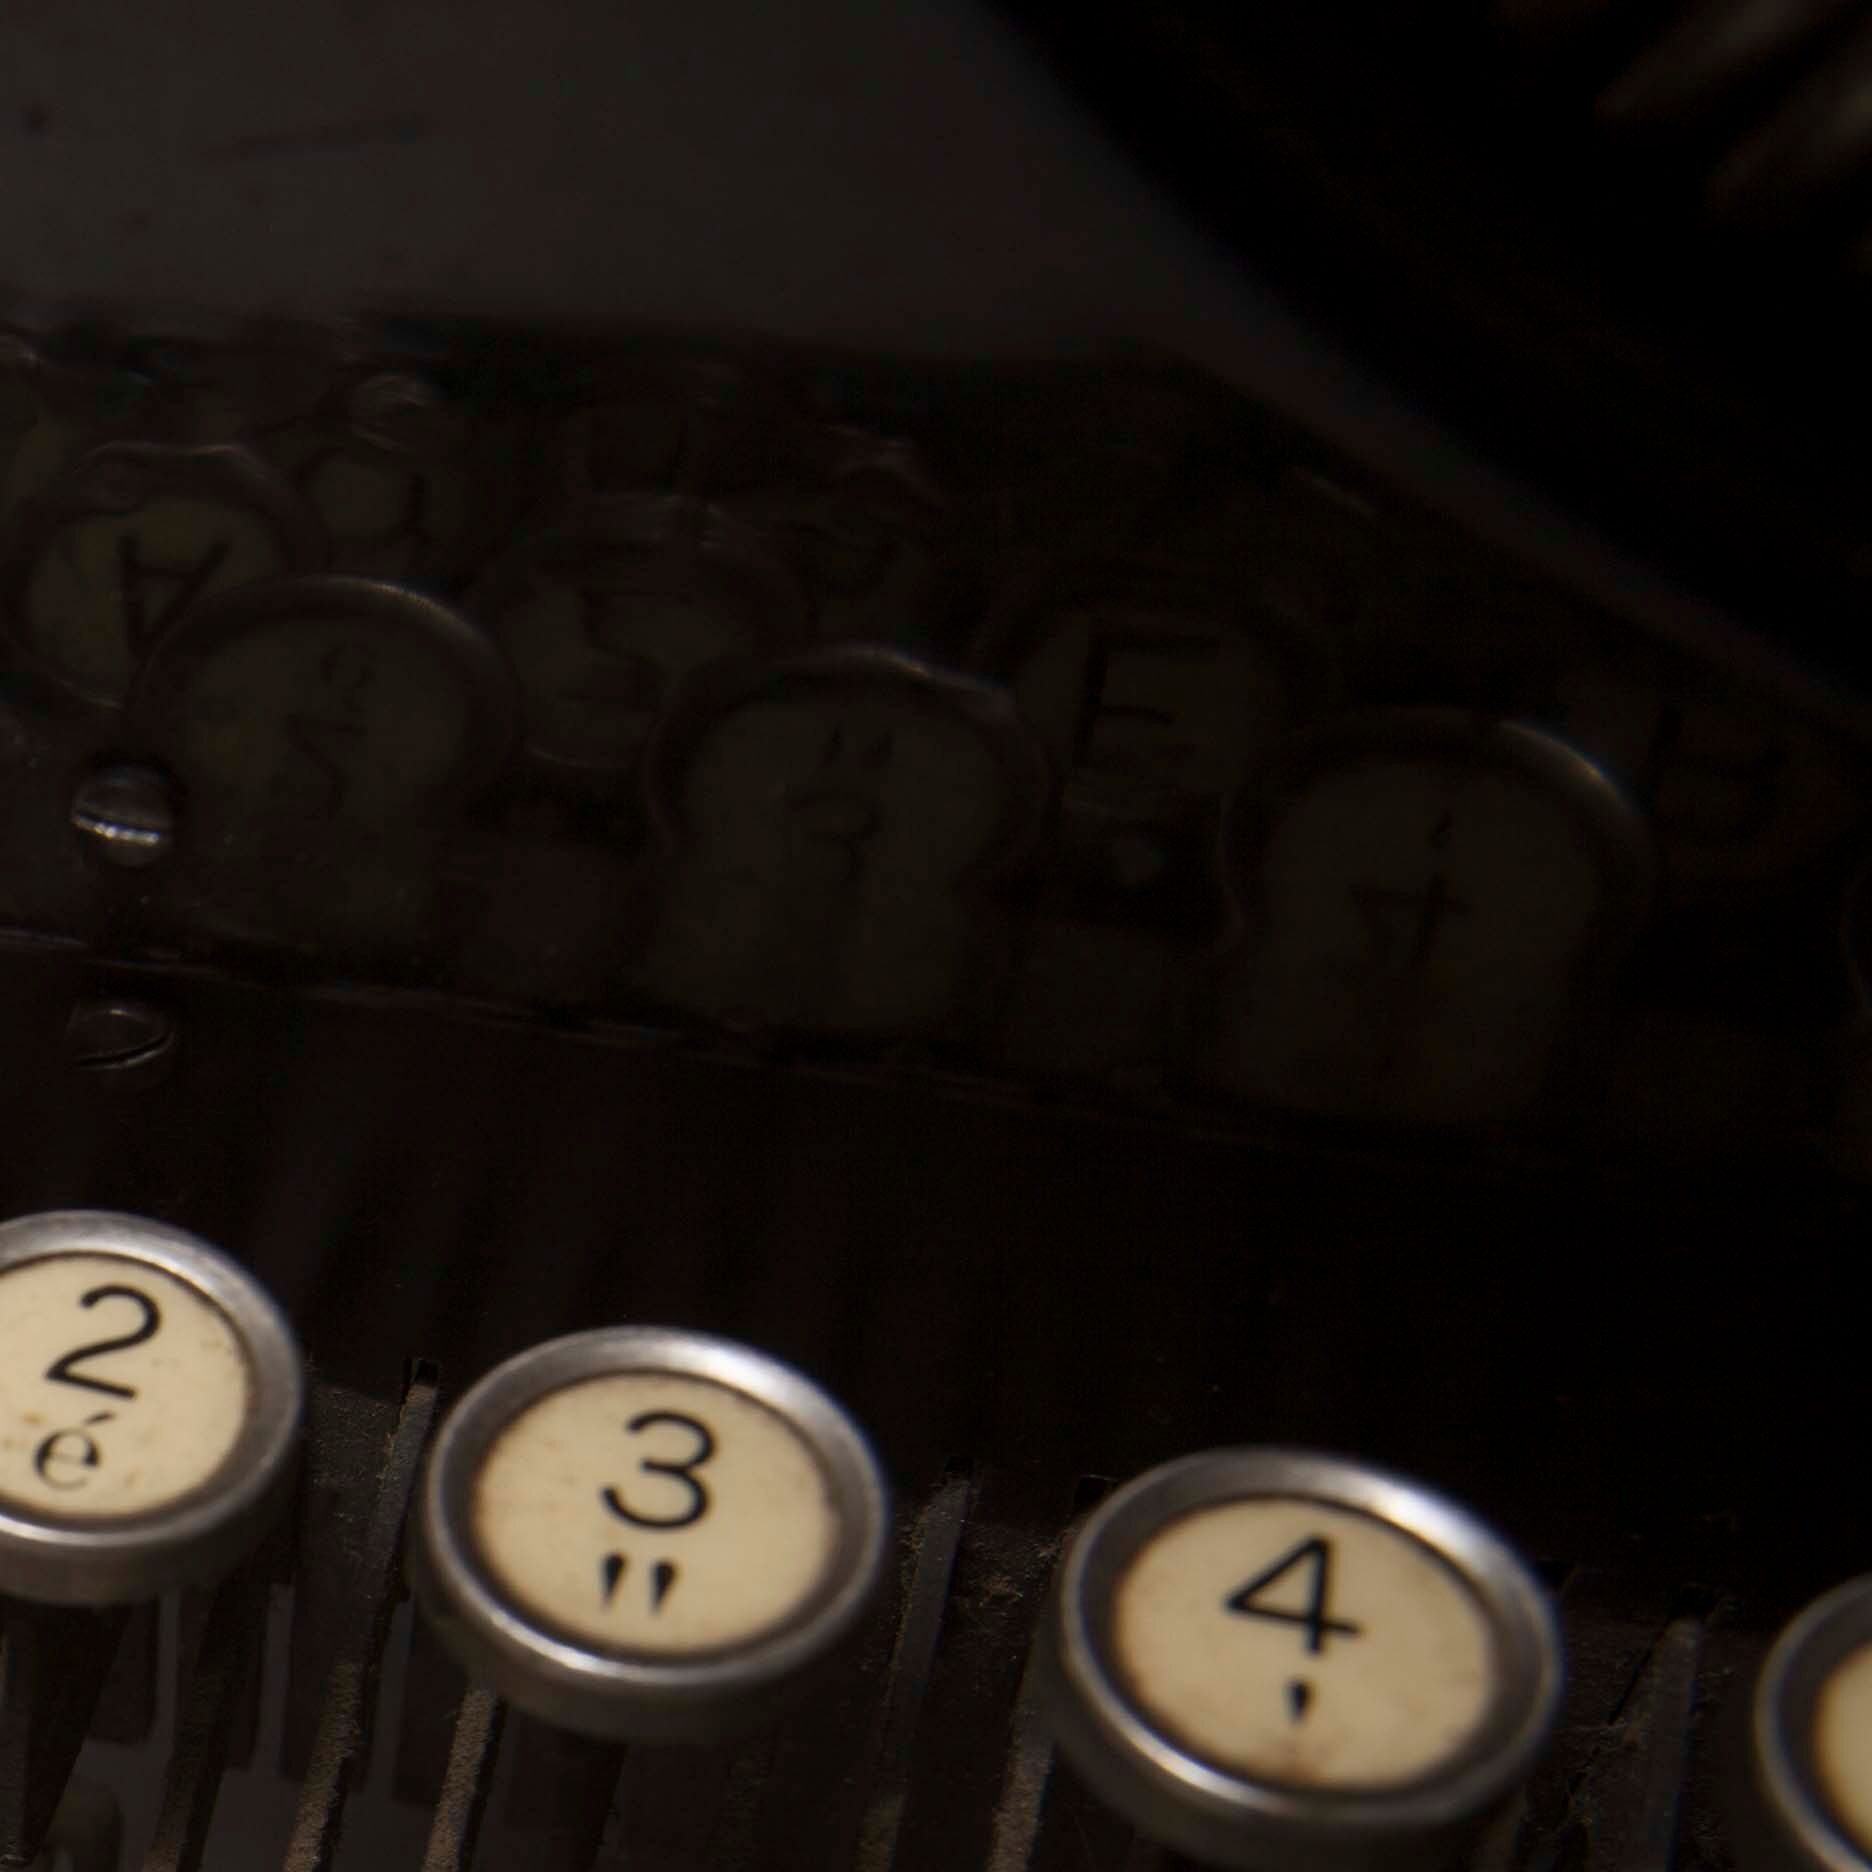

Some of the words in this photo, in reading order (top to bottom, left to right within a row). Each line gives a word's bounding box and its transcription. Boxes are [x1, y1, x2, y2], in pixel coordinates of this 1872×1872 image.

[46, 1285, 163, 1399] 2
[33, 1411, 113, 1488] é
[601, 1410, 717, 1532] 3
[1224, 1535, 1363, 1656] 4
